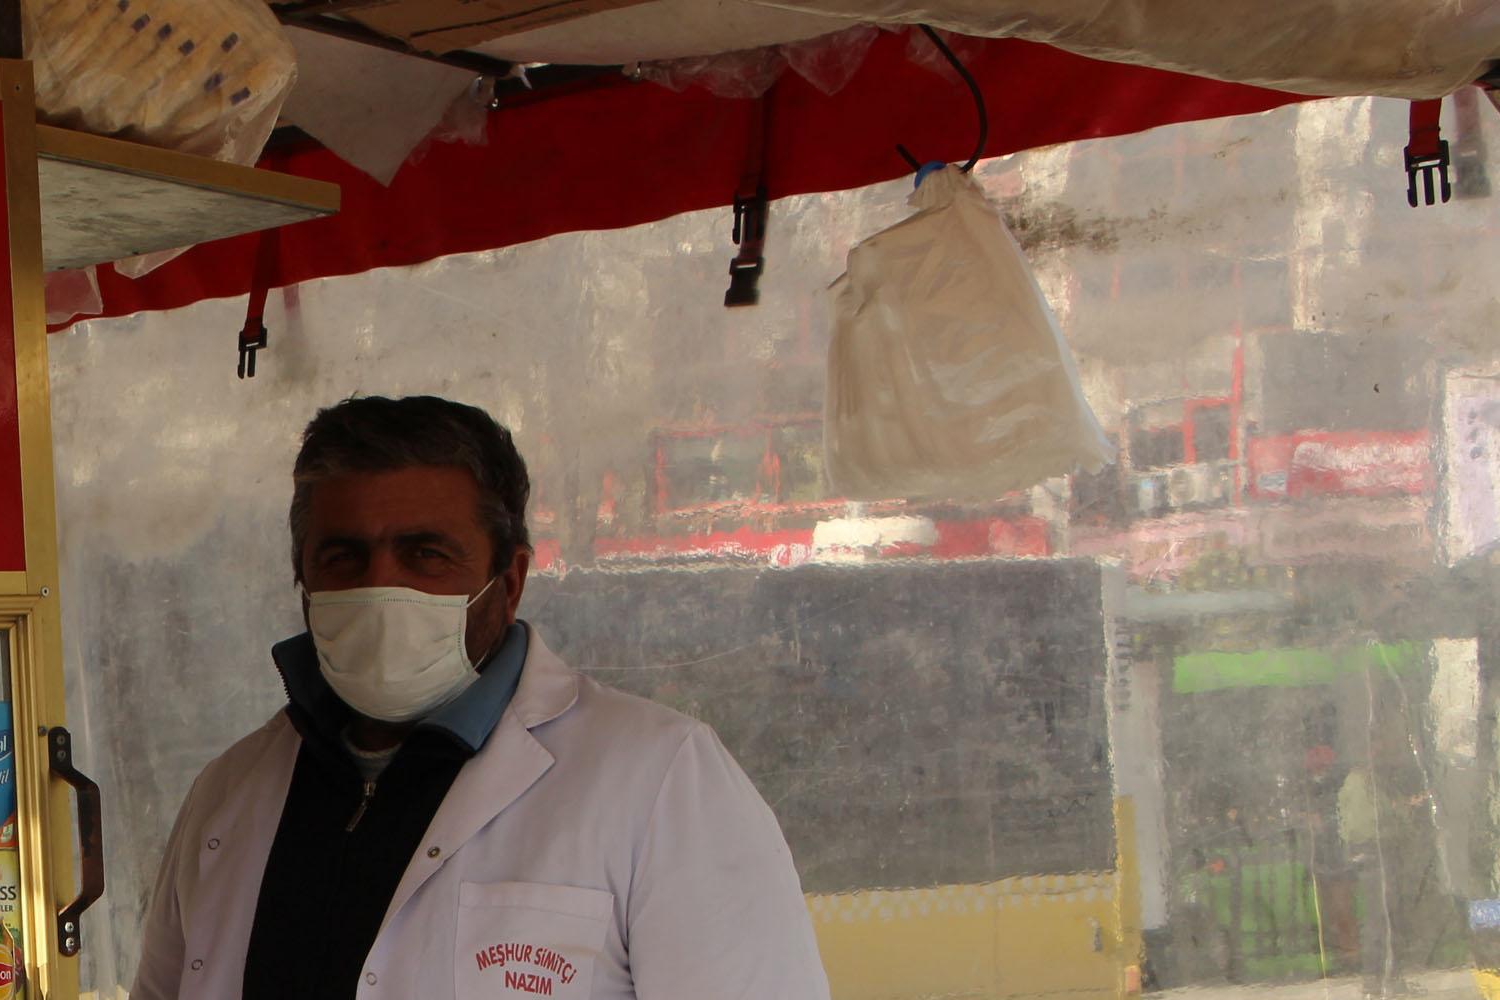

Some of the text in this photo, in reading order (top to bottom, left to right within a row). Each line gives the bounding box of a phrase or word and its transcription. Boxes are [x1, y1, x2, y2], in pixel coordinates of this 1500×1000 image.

[476, 943, 577, 984] MEŞHUR SİMİTÇİ
[505, 970, 552, 996] NAZIM
